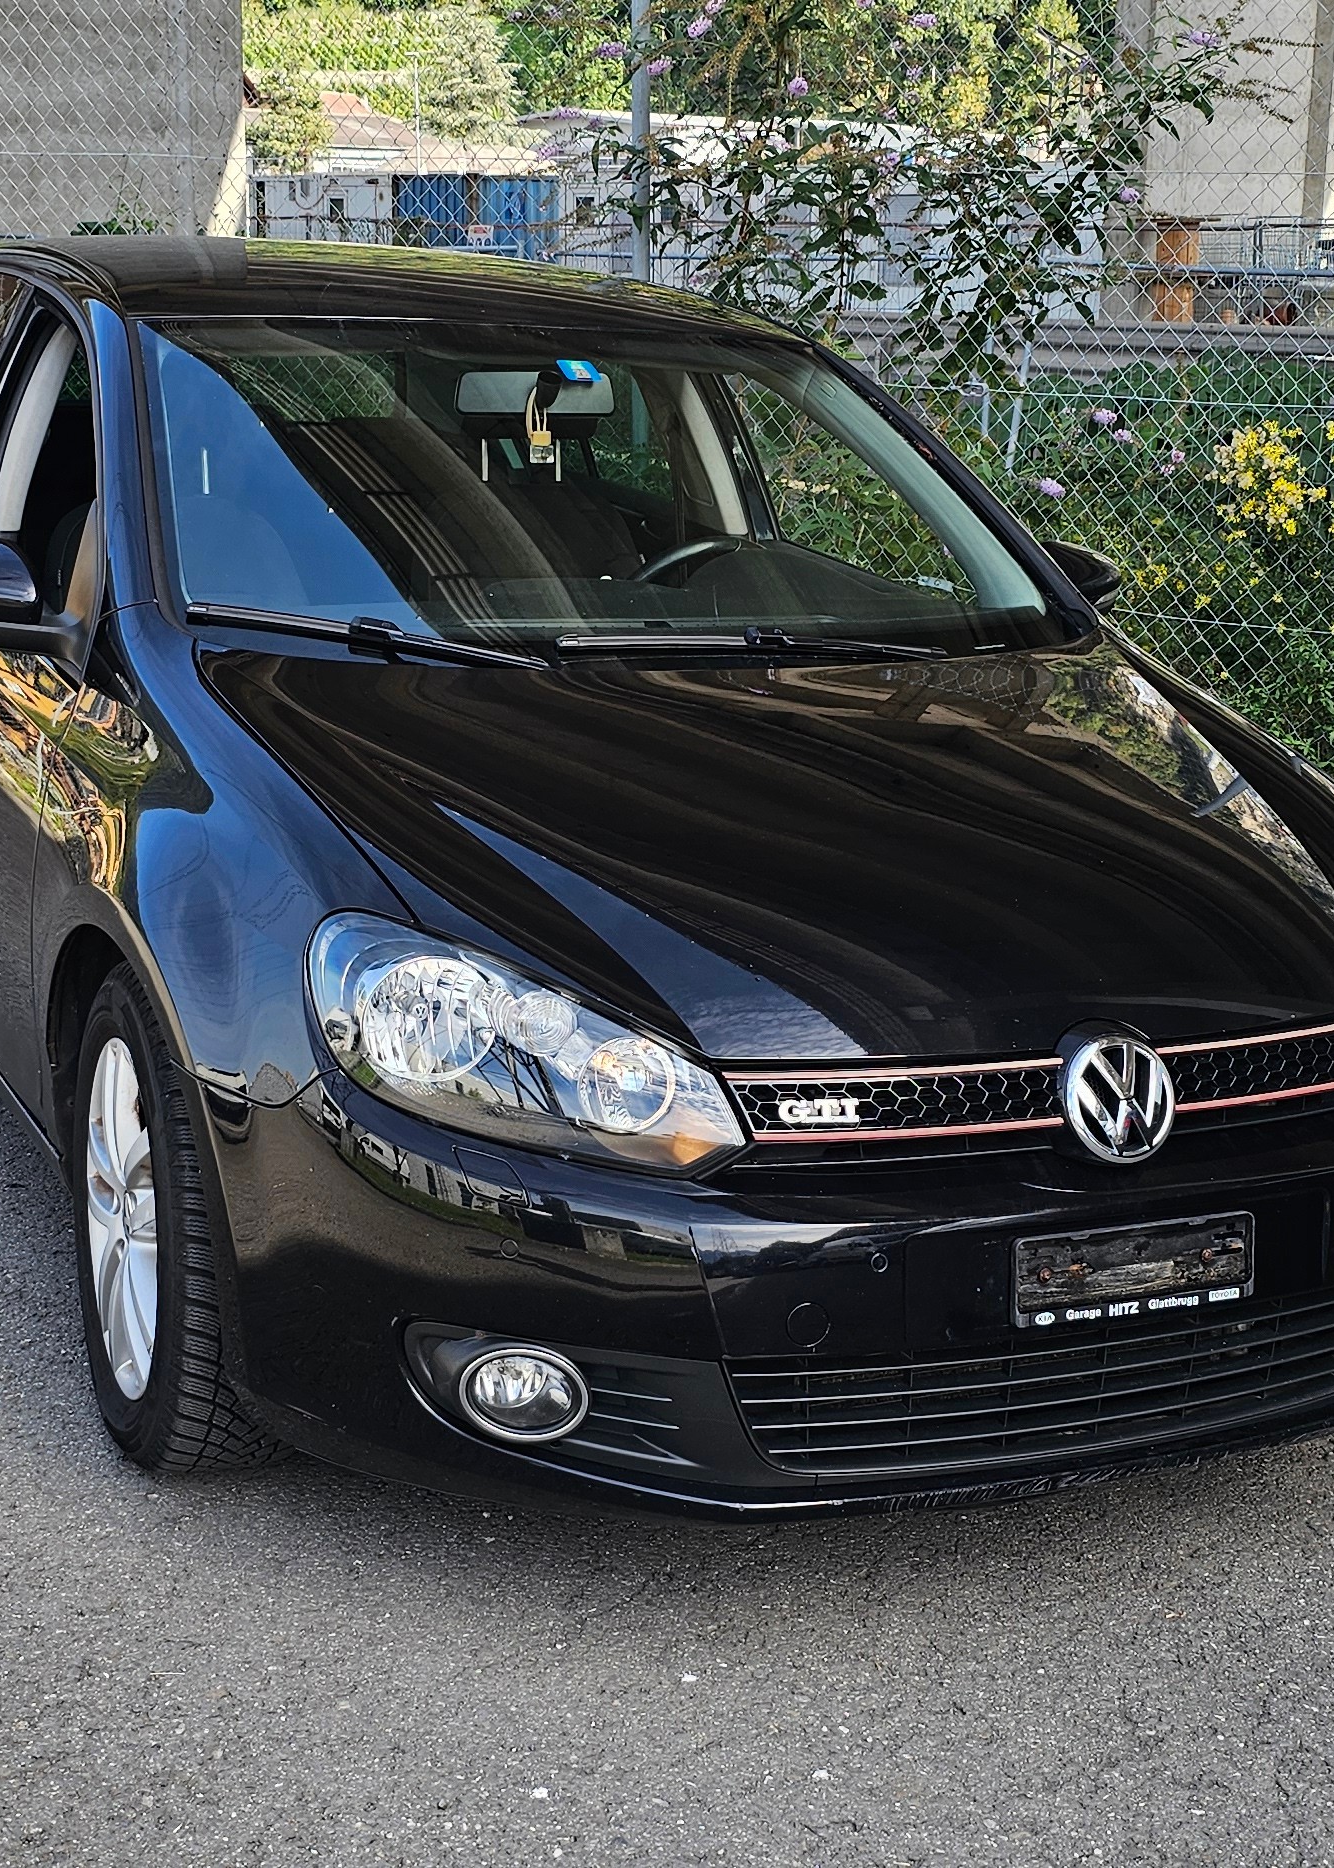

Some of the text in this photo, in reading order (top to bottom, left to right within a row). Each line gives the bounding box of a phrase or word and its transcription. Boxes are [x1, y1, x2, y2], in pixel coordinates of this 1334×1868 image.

[778, 1098, 860, 1124] GTI
[1065, 1308, 1102, 1320] Garage
[1108, 1301, 1140, 1317] HITZ
[1148, 1295, 1200, 1310] Glattbrugg
[1211, 1289, 1238, 1299] TOYOTA
